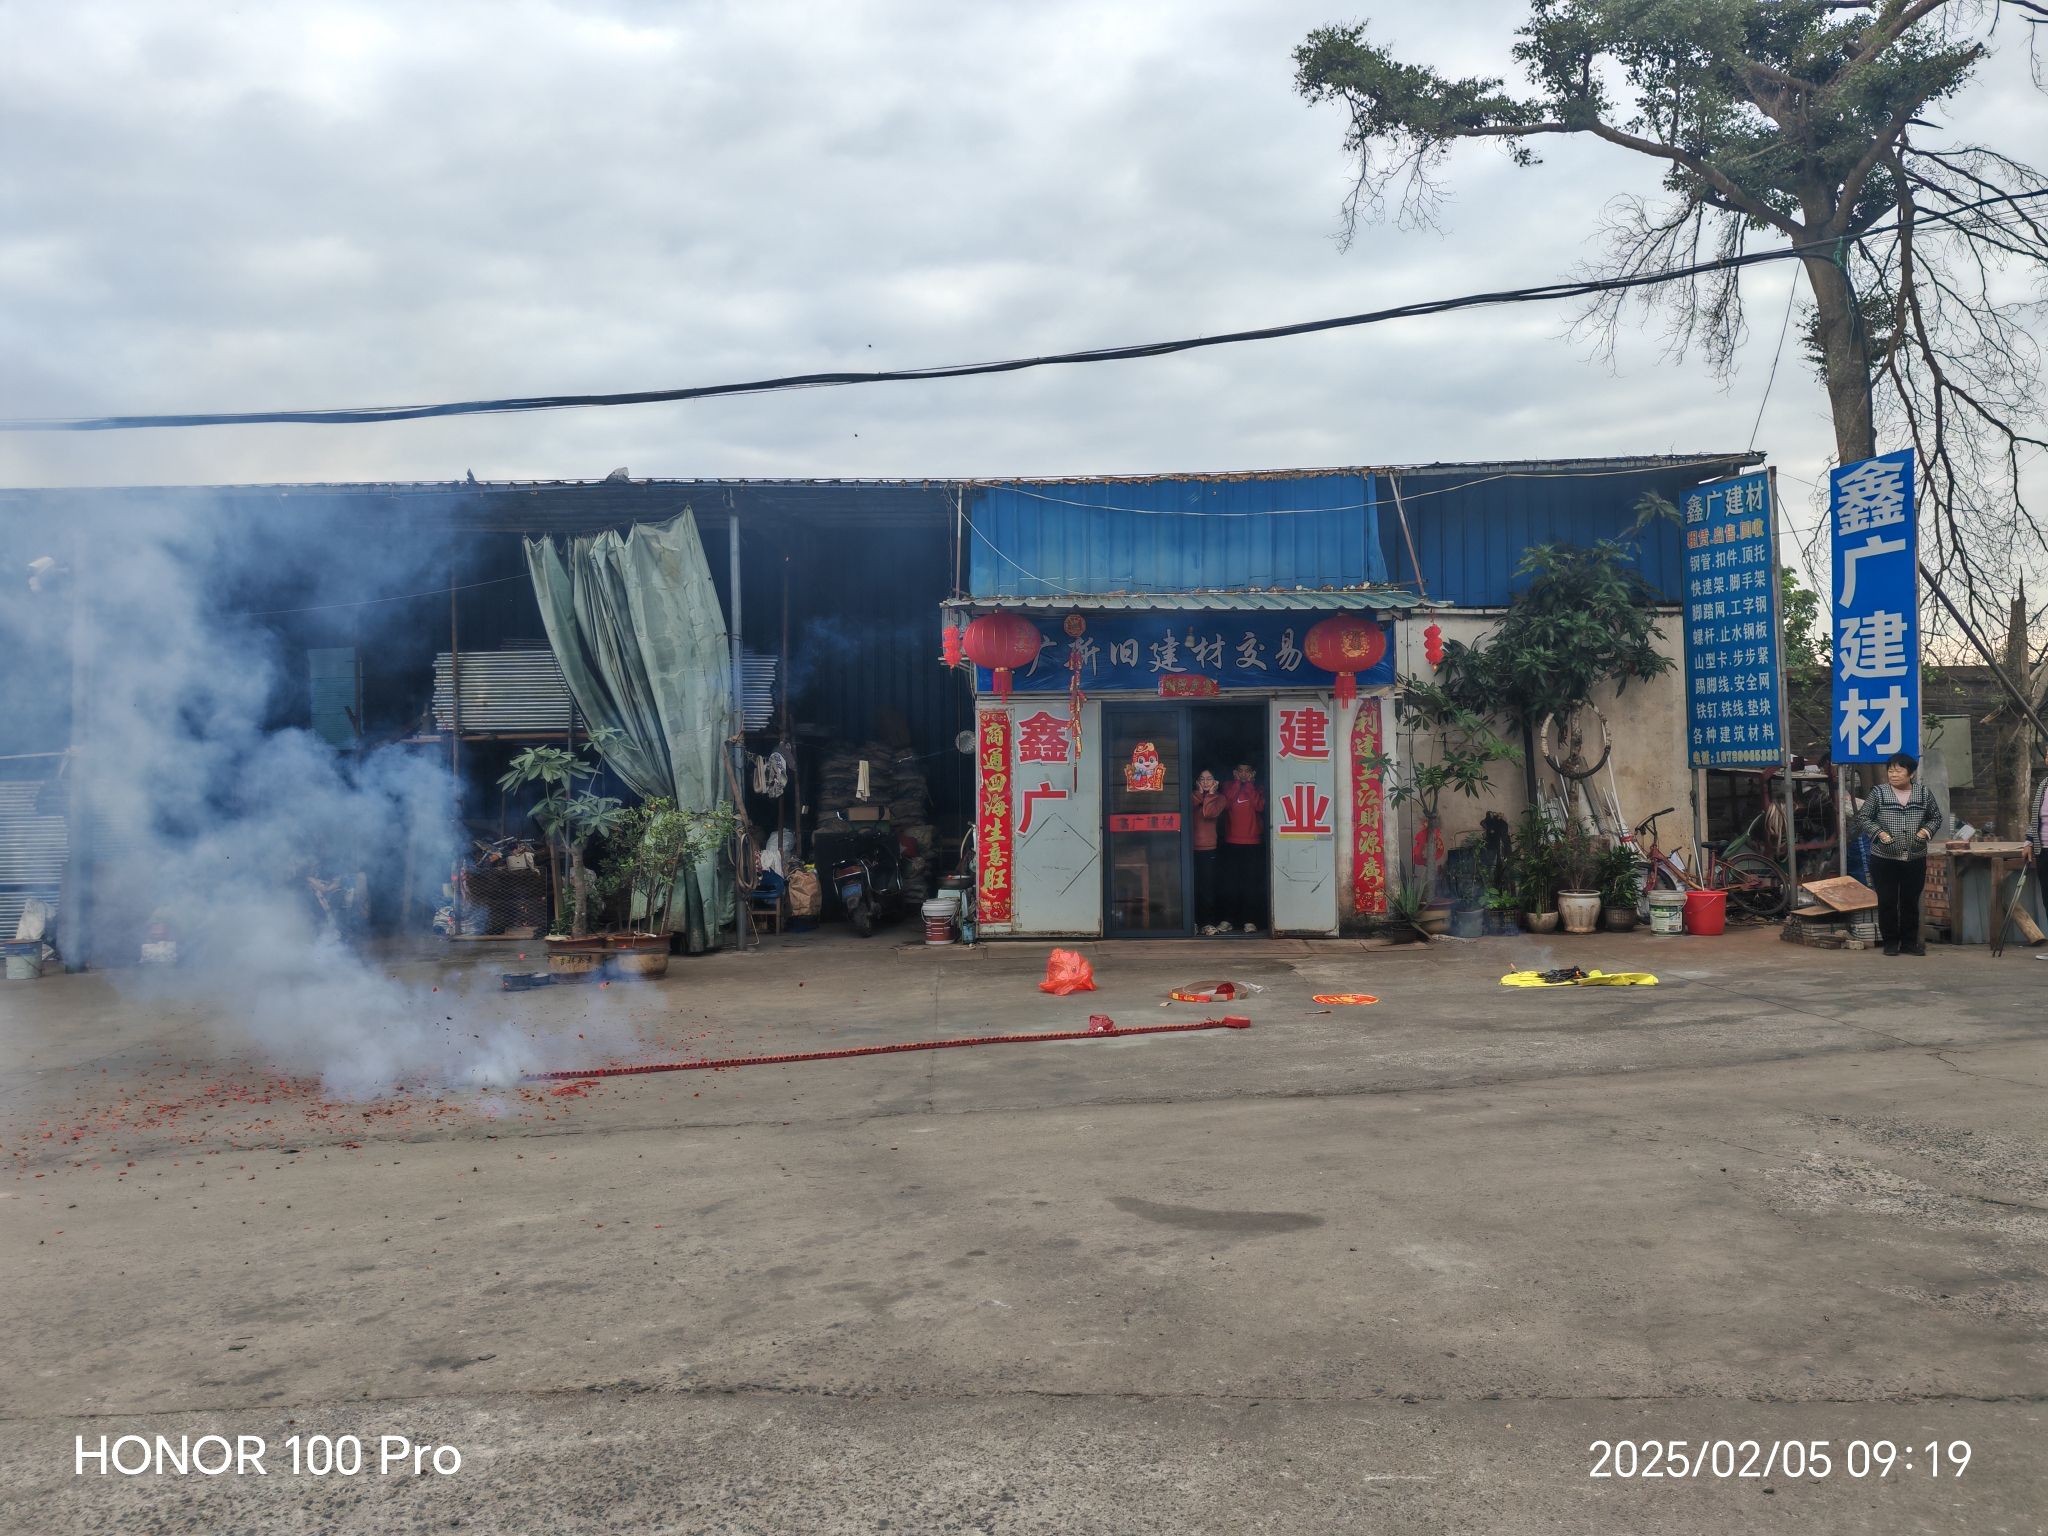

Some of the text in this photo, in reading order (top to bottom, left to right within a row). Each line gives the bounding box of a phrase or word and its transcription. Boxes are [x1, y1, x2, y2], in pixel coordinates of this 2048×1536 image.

[1686, 480, 1764, 524] 鑫广建材
[1012, 628, 1303, 678] 广新旧建材交易
[1836, 459, 1909, 756] 鑫广建材
[1017, 711, 1071, 836] 鑫广
[1278, 707, 1332, 834] 建业
[1693, 722, 1775, 744] 各种建筑材料
[982, 722, 1009, 890] 商通四海生意旺
